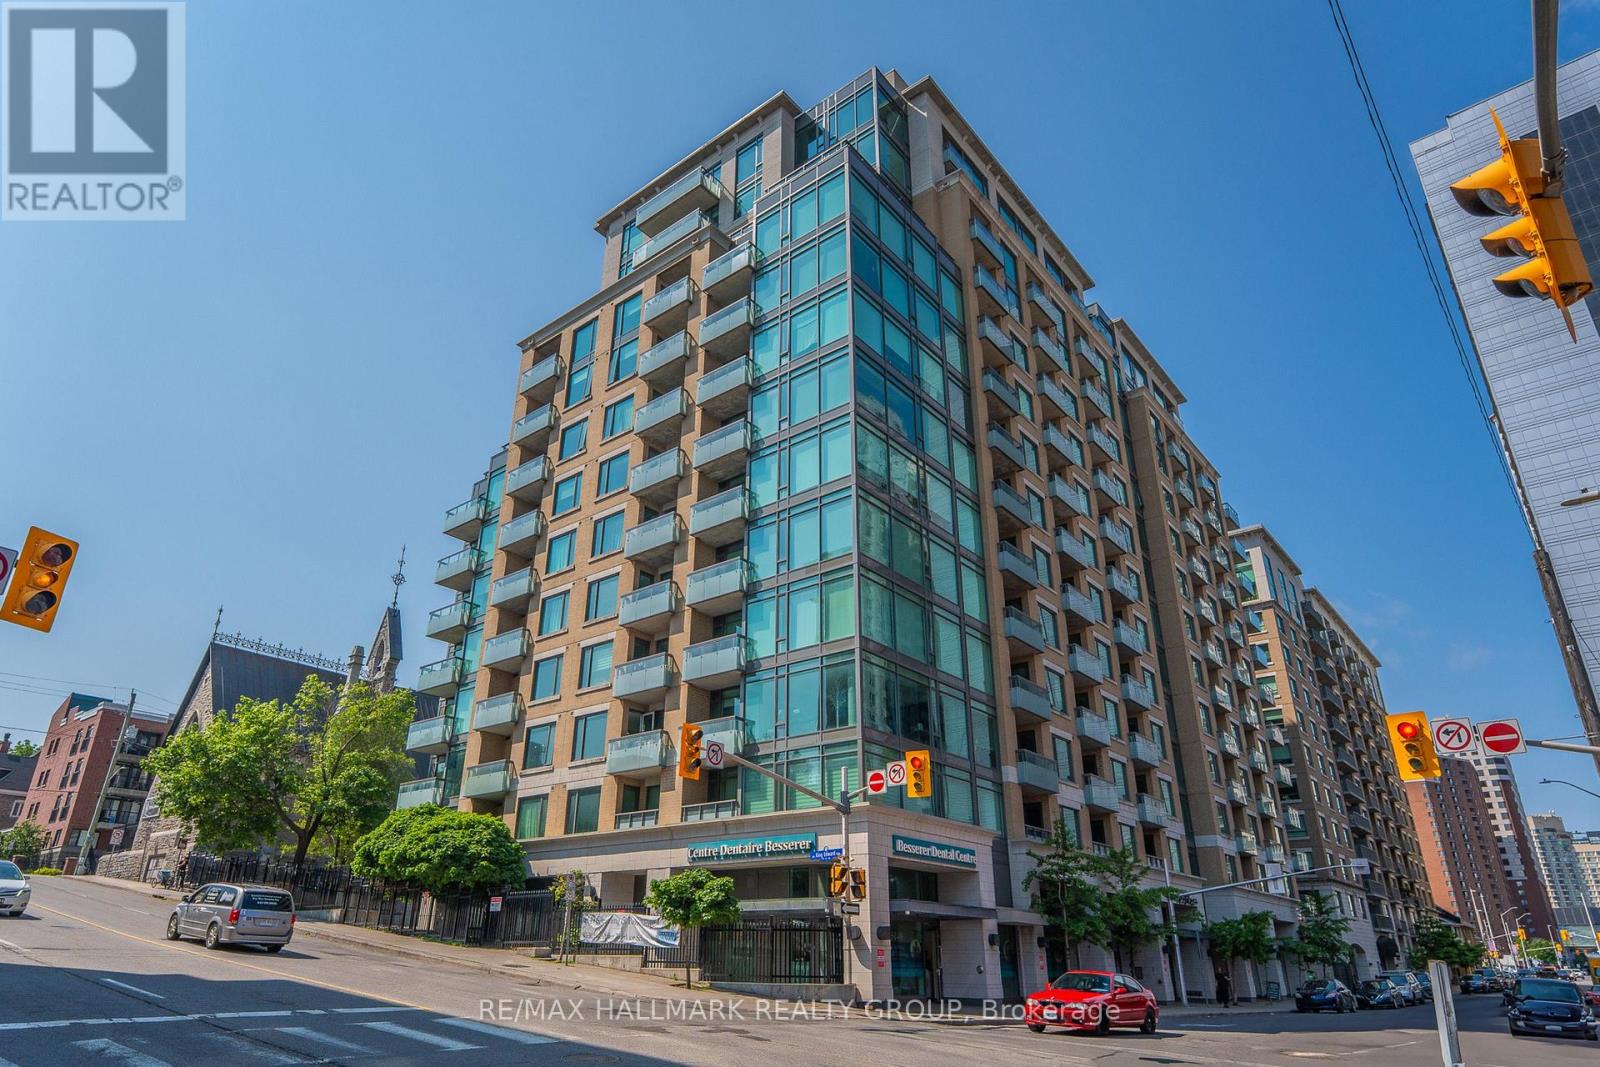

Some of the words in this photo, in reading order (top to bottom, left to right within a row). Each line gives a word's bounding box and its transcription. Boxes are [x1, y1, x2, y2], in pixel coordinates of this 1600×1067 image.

[688, 846, 718, 858] Centre
[720, 842, 763, 856] Dentaire
[765, 839, 812, 852] Besserer
[895, 839, 932, 856] Besserer
[931, 845, 955, 860] Dental
[955, 850, 977, 865] Centre
